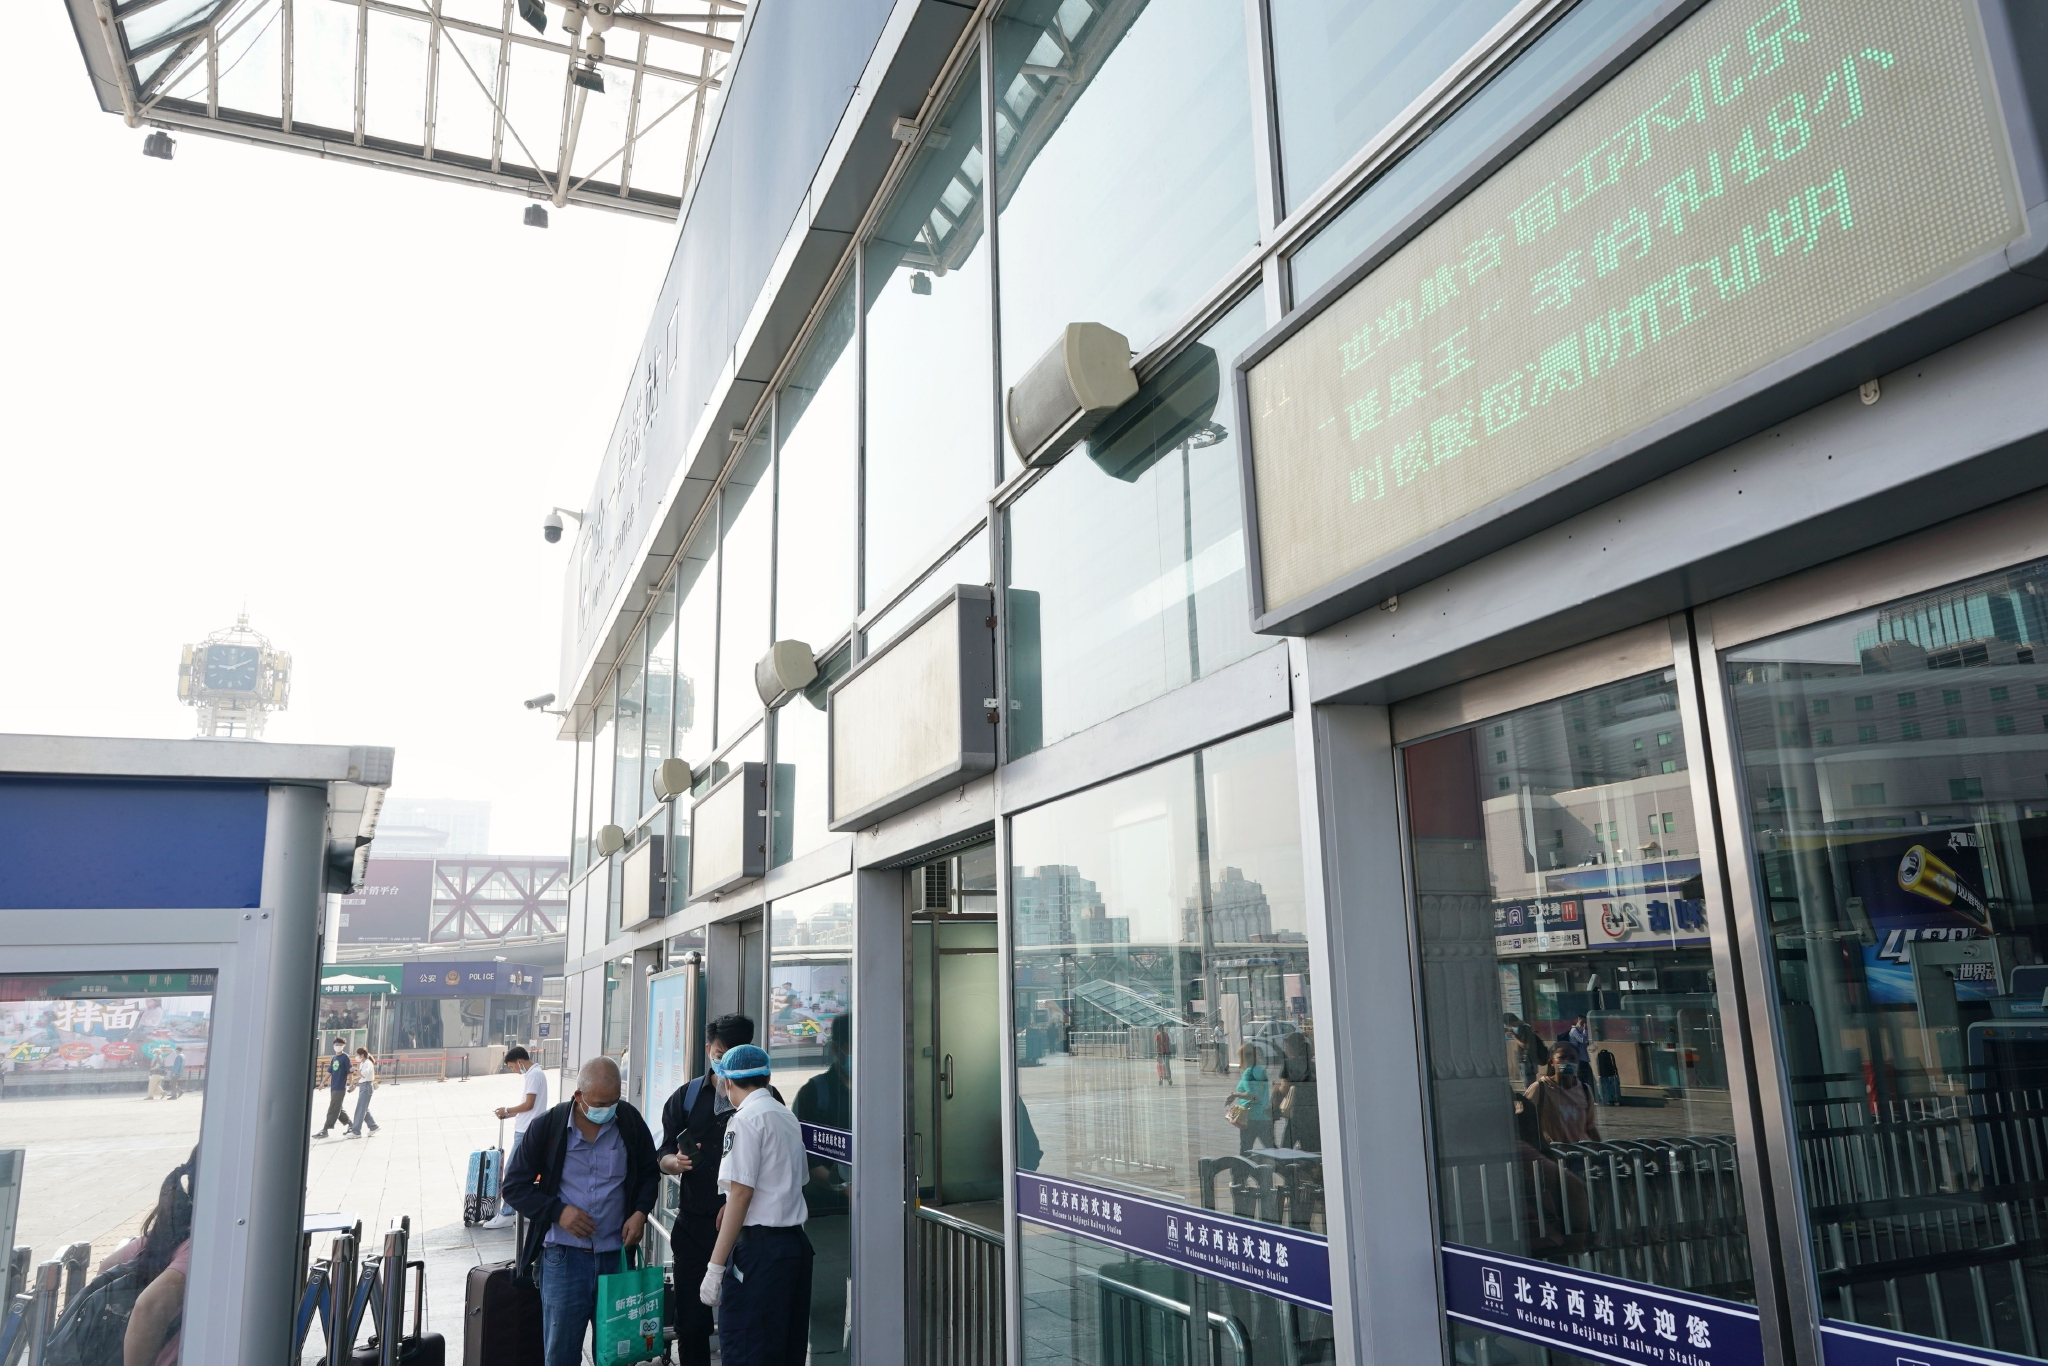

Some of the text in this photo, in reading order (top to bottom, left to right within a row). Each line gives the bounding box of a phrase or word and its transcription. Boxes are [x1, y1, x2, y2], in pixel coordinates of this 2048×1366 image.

[419, 973, 437, 983] 公安
[469, 972, 495, 981] POLICE
[53, 1000, 142, 1033] 拌面
[1052, 1188, 1122, 1222] 北京西站欢迎您
[1052, 1209, 1067, 1220] Welcome
[1072, 1215, 1090, 1227] Beijingxi
[1090, 1219, 1106, 1233] Railway
[1106, 1224, 1122, 1236] Station
[1184, 1221, 1289, 1268] 北京西站欢迎您
[1185, 1246, 1207, 1261] Welcome
[1208, 1253, 1214, 1263] to
[1215, 1255, 1241, 1271] Beijingxi
[1241, 1262, 1265, 1279] Railway
[1266, 1269, 1289, 1284] Station
[615, 1292, 645, 1312] 新东方
[1513, 1276, 1712, 1349] 北京西站欢迎您
[1516, 1308, 1556, 1329] Welcome
[1559, 1320, 1569, 1333] to
[1572, 1322, 1618, 1346] Beijingxi
[1622, 1335, 1665, 1361] Railway
[1669, 1347, 1711, 1366] Station
